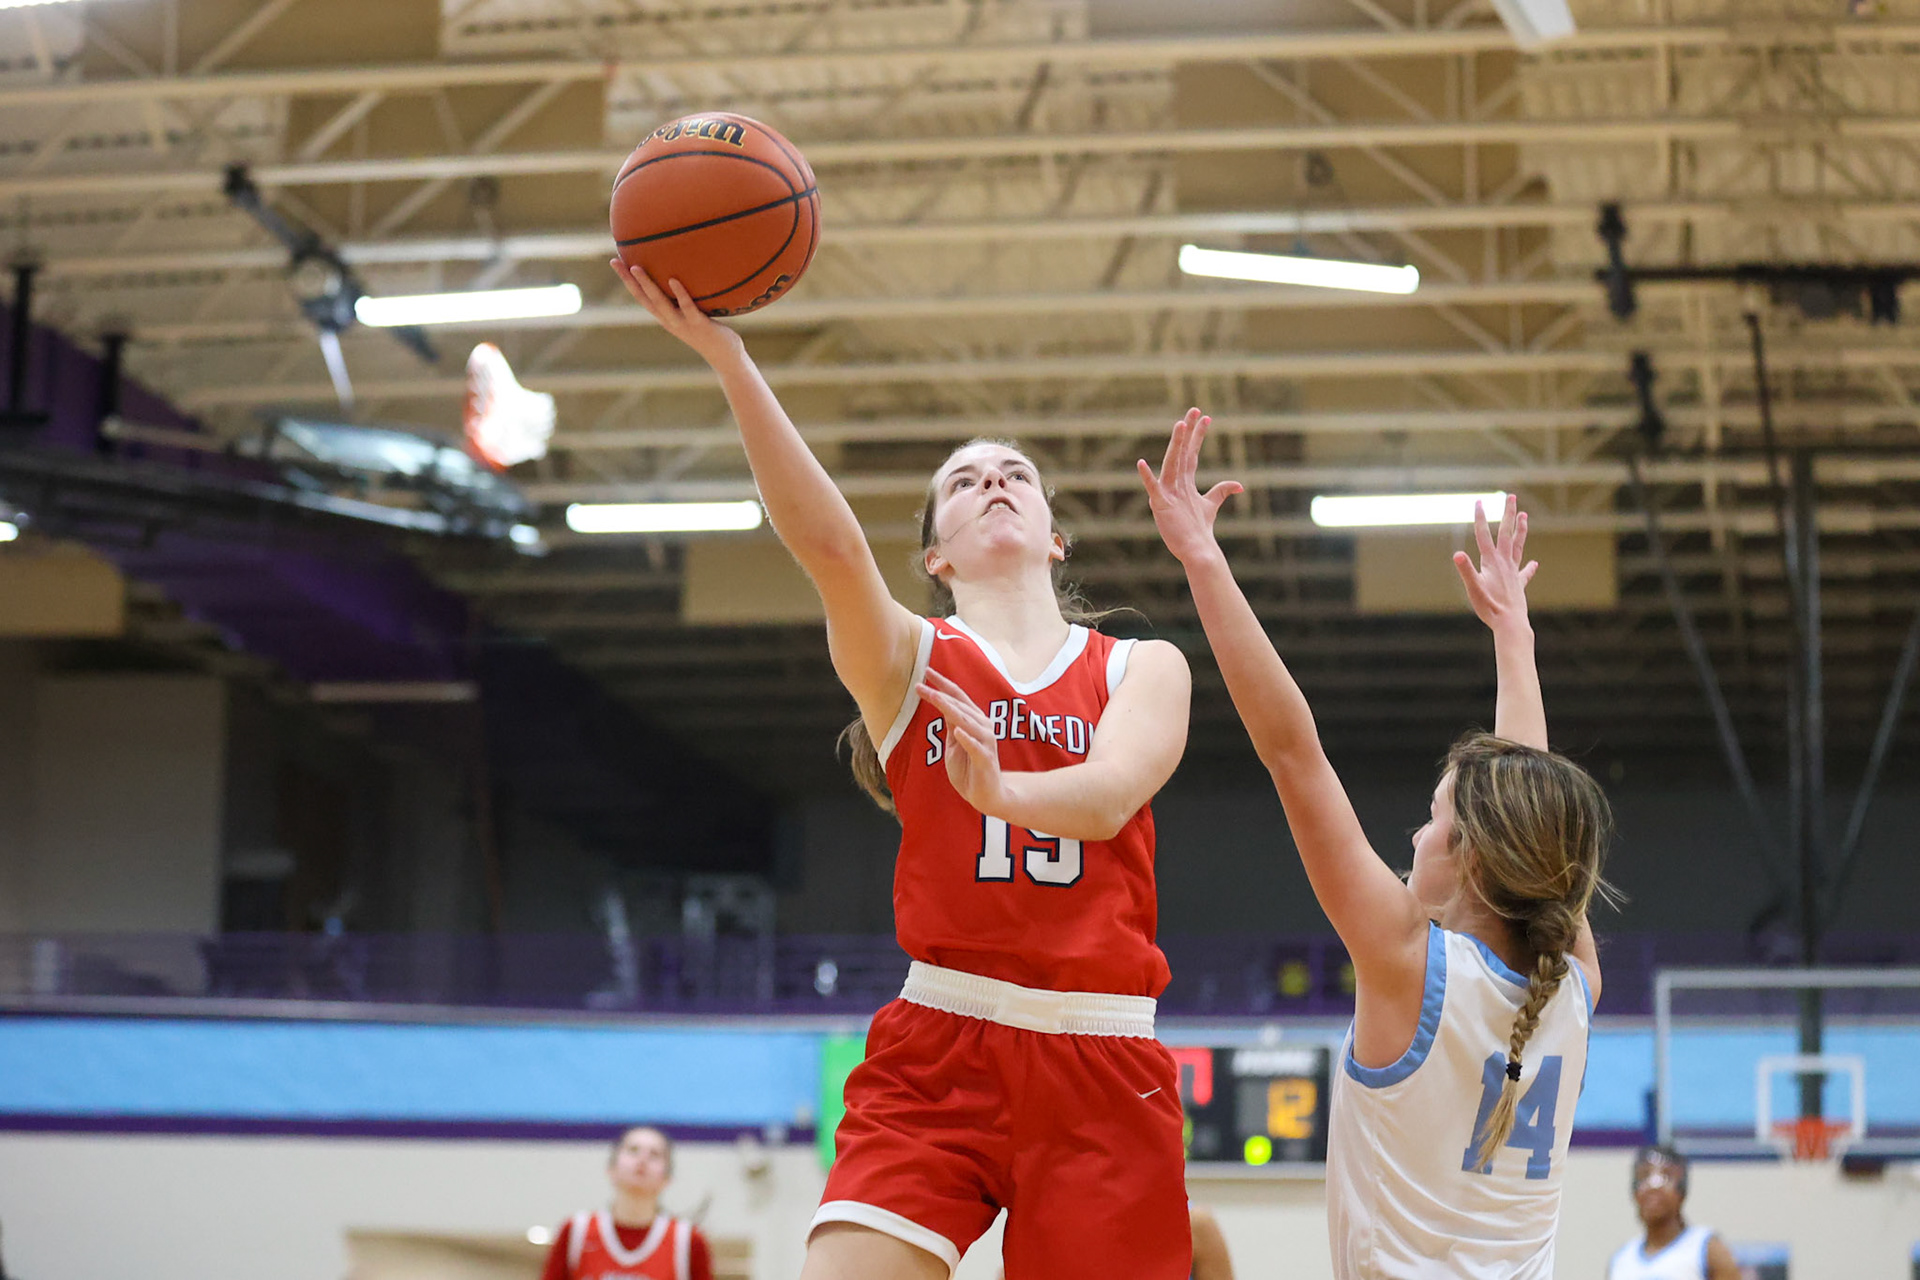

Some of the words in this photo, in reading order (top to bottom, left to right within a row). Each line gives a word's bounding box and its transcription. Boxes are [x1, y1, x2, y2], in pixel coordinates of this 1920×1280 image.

[926, 716, 944, 767] S
[988, 697, 1097, 755] BENEDI
[1461, 1050, 1563, 1180] 14
